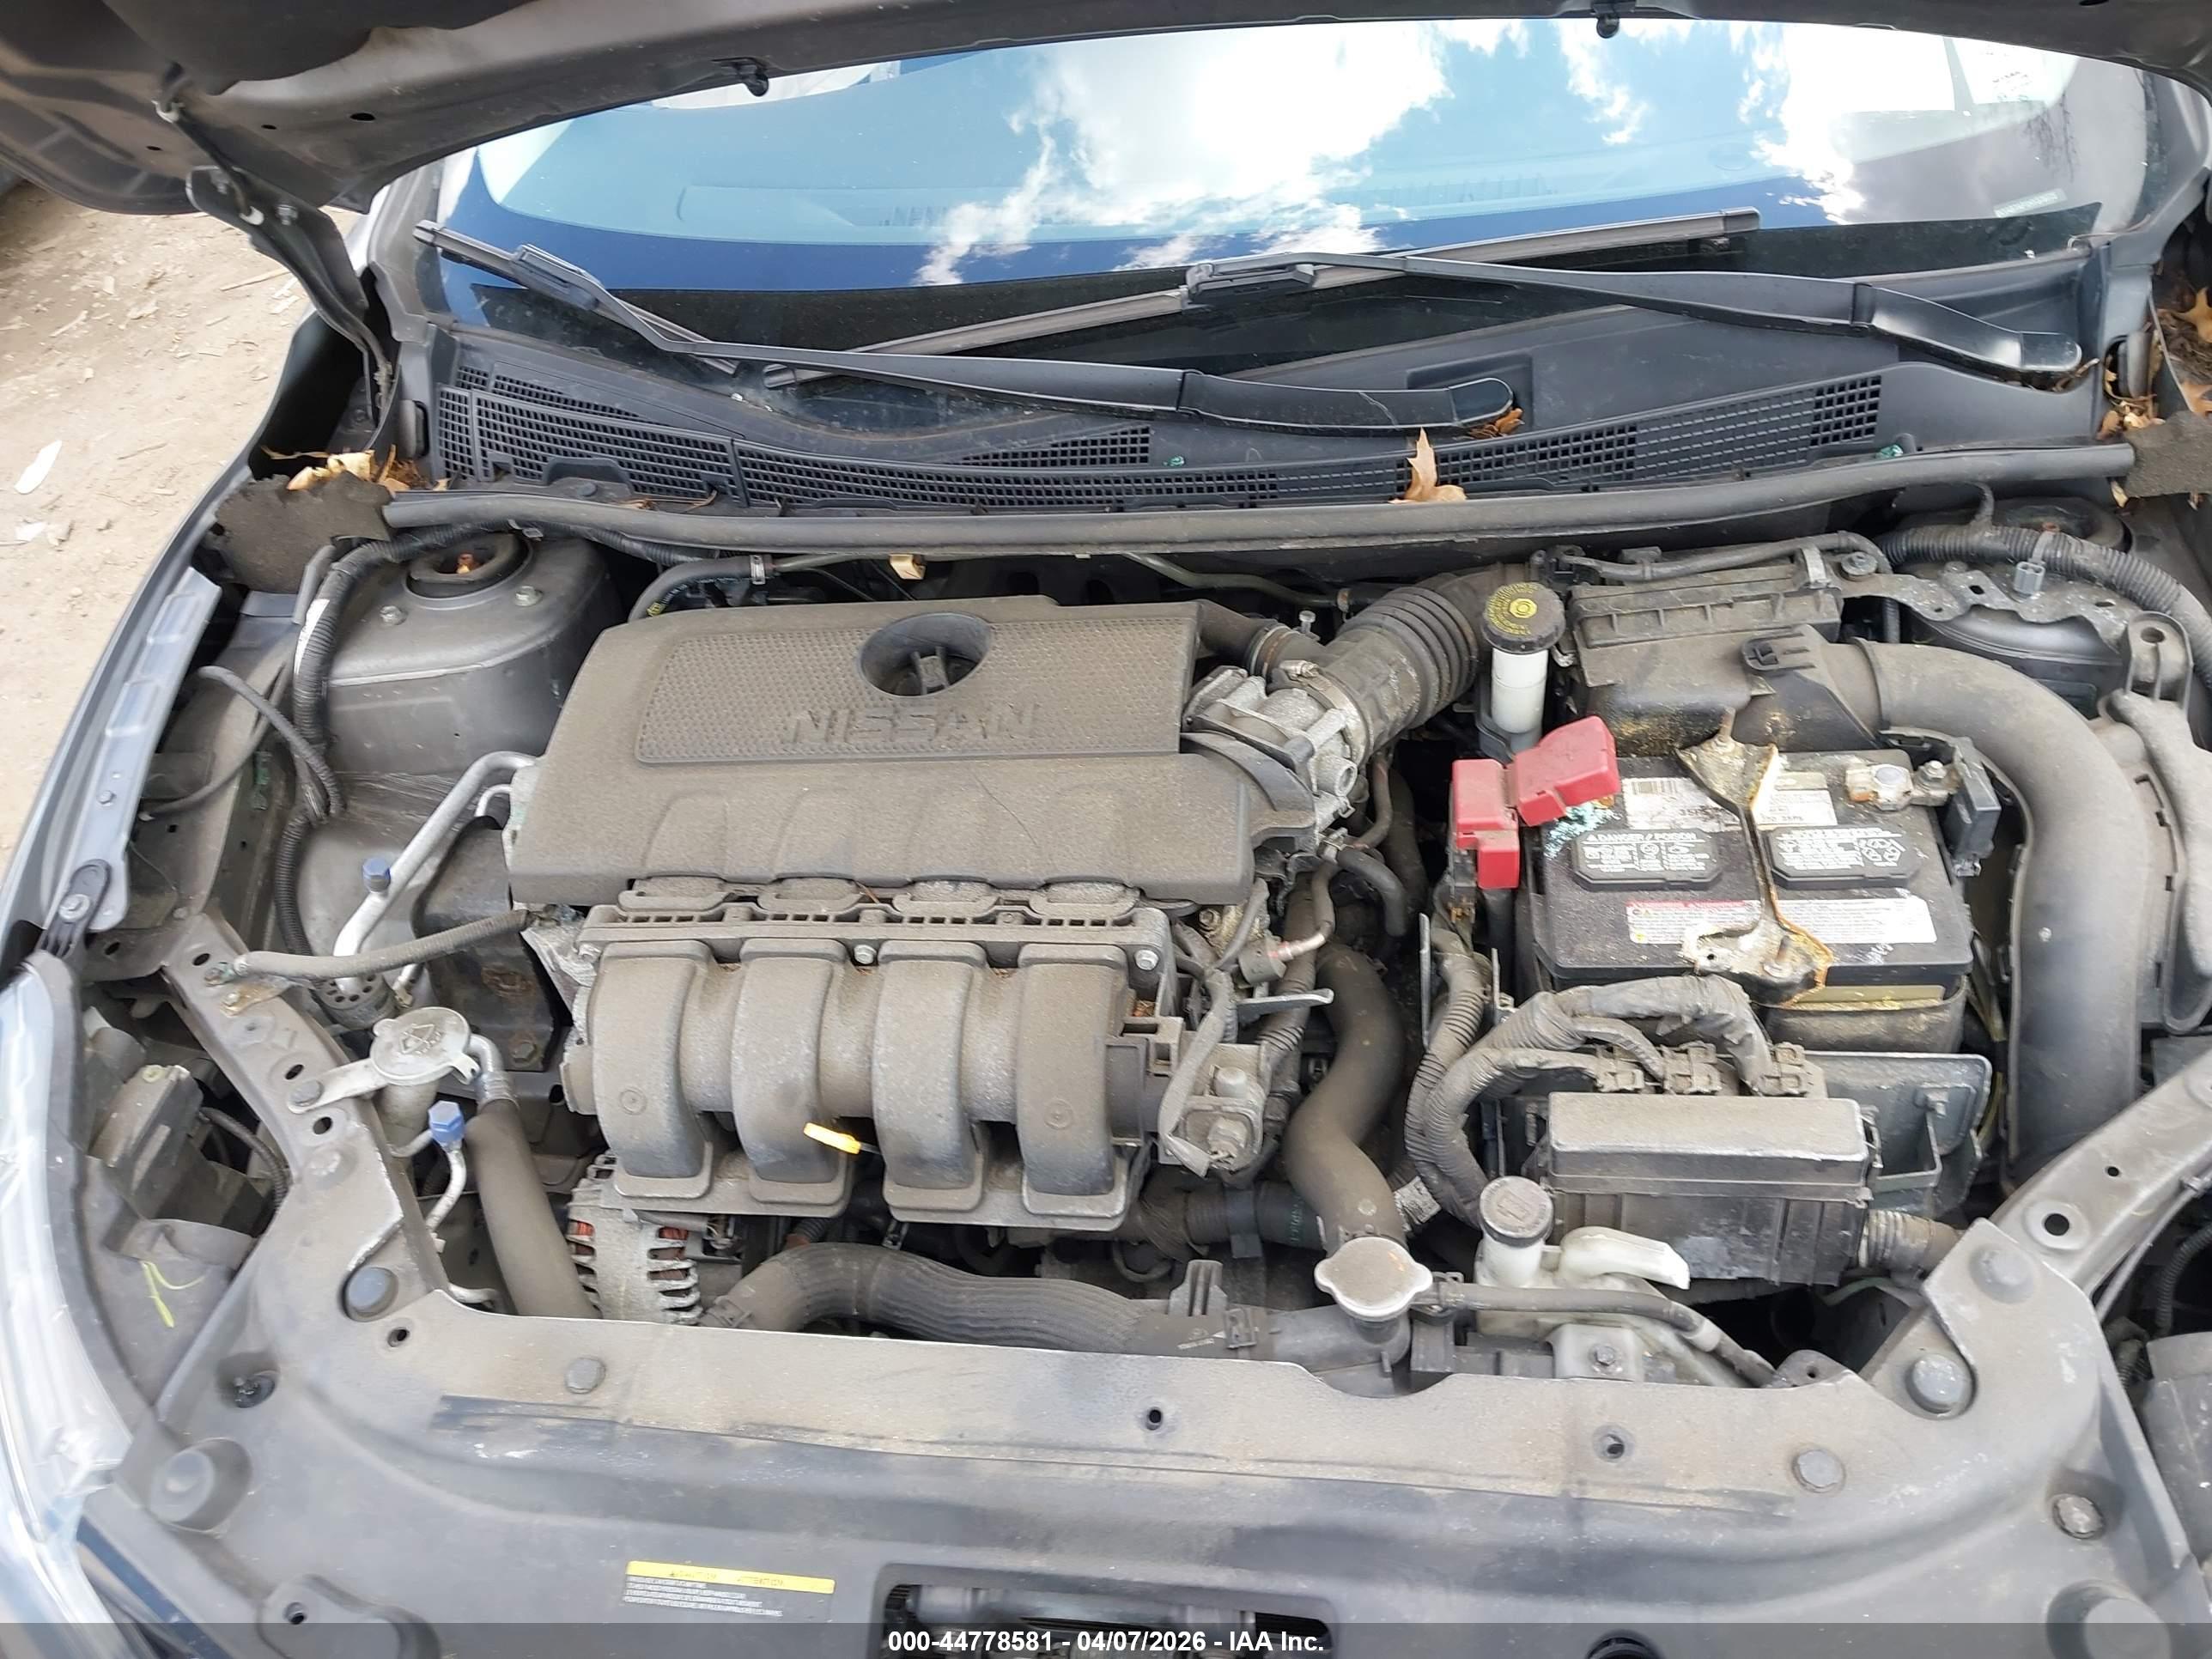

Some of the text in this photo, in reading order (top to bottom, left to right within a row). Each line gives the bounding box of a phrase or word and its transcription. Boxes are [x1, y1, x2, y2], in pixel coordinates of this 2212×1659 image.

[784, 702, 1041, 744] NISSAN
[1597, 833, 1644, 842] DANGER
[1654, 832, 1698, 841] POISON
